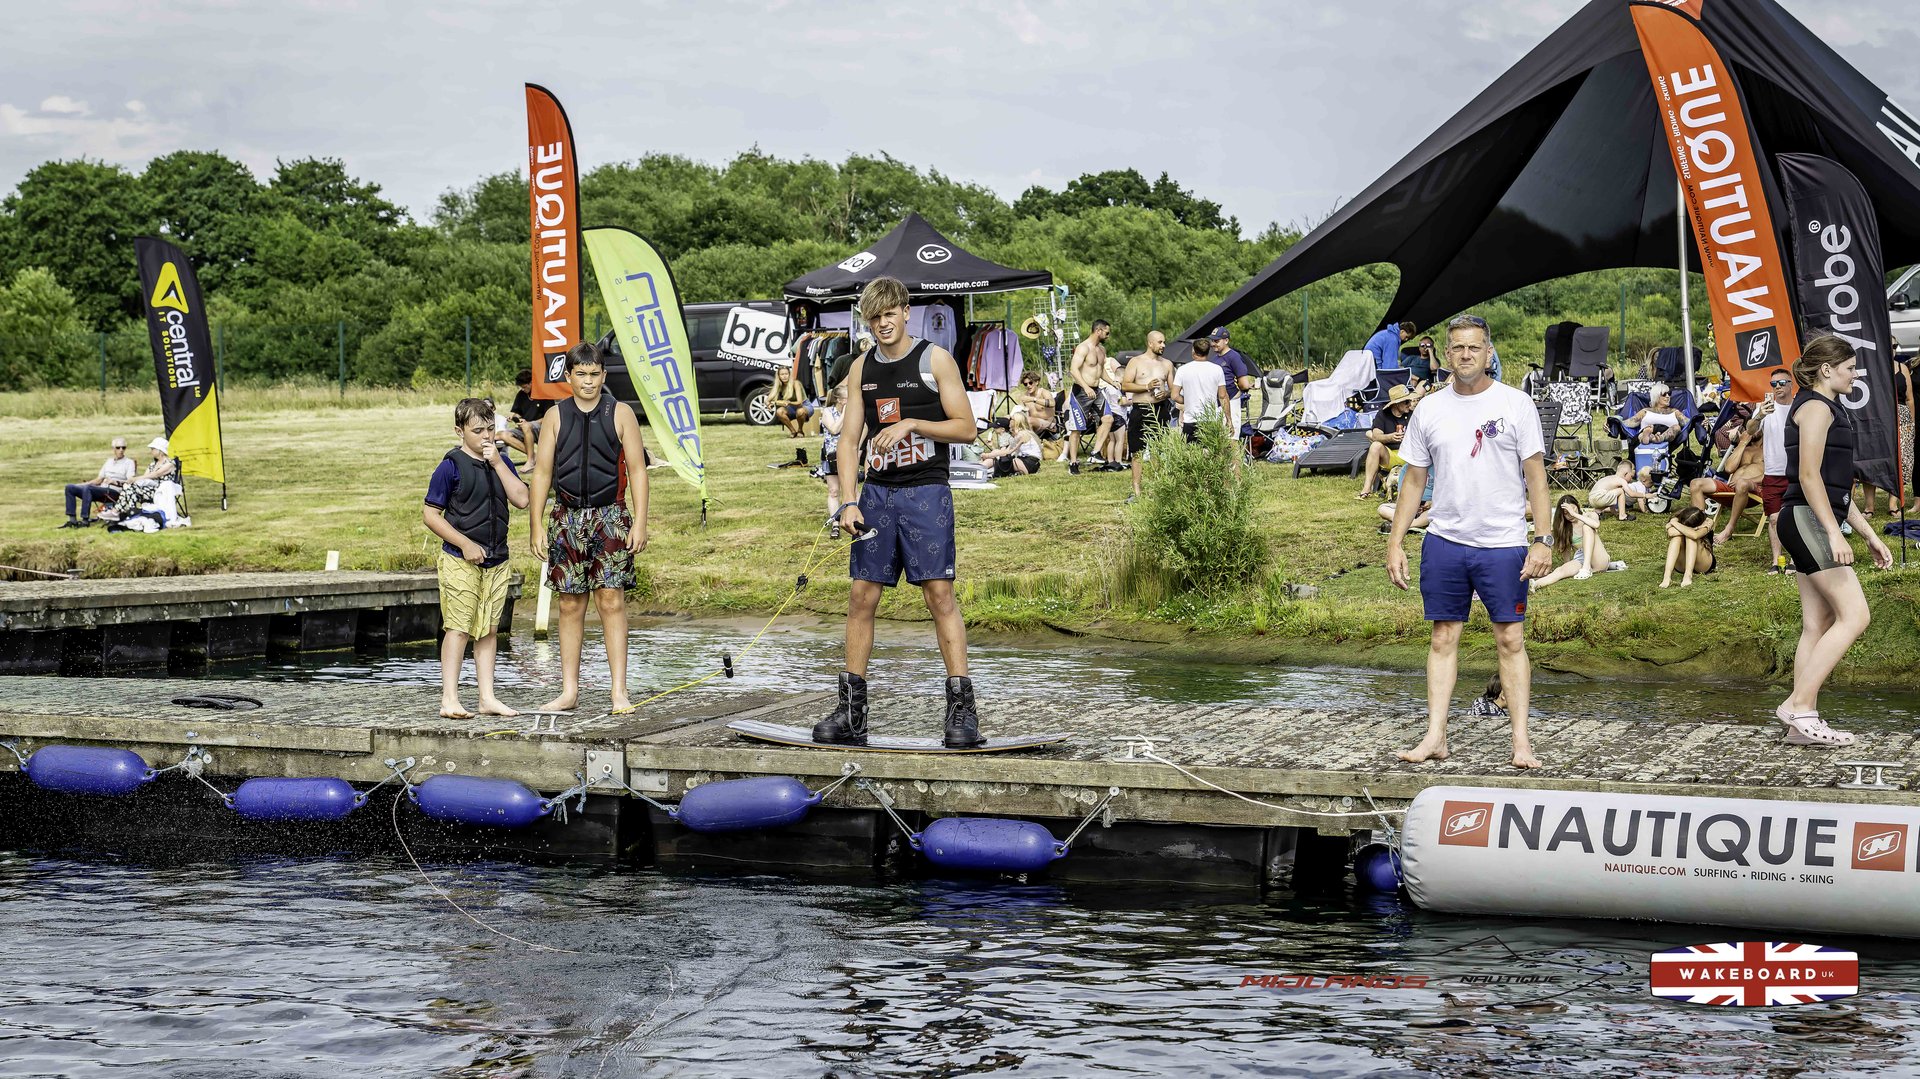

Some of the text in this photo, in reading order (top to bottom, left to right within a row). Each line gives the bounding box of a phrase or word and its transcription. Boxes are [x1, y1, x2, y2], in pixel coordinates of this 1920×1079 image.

[920, 279, 990, 291] brocerystore.com
[158, 312, 177, 389] IT SOLUTIONS
[166, 310, 200, 388] central
[871, 443, 928, 472] OPEN
[1498, 802, 1838, 867] NAUTIQUE
[1604, 861, 1834, 886] NAUTIQUE.COM SURFING RIDING SKIING
